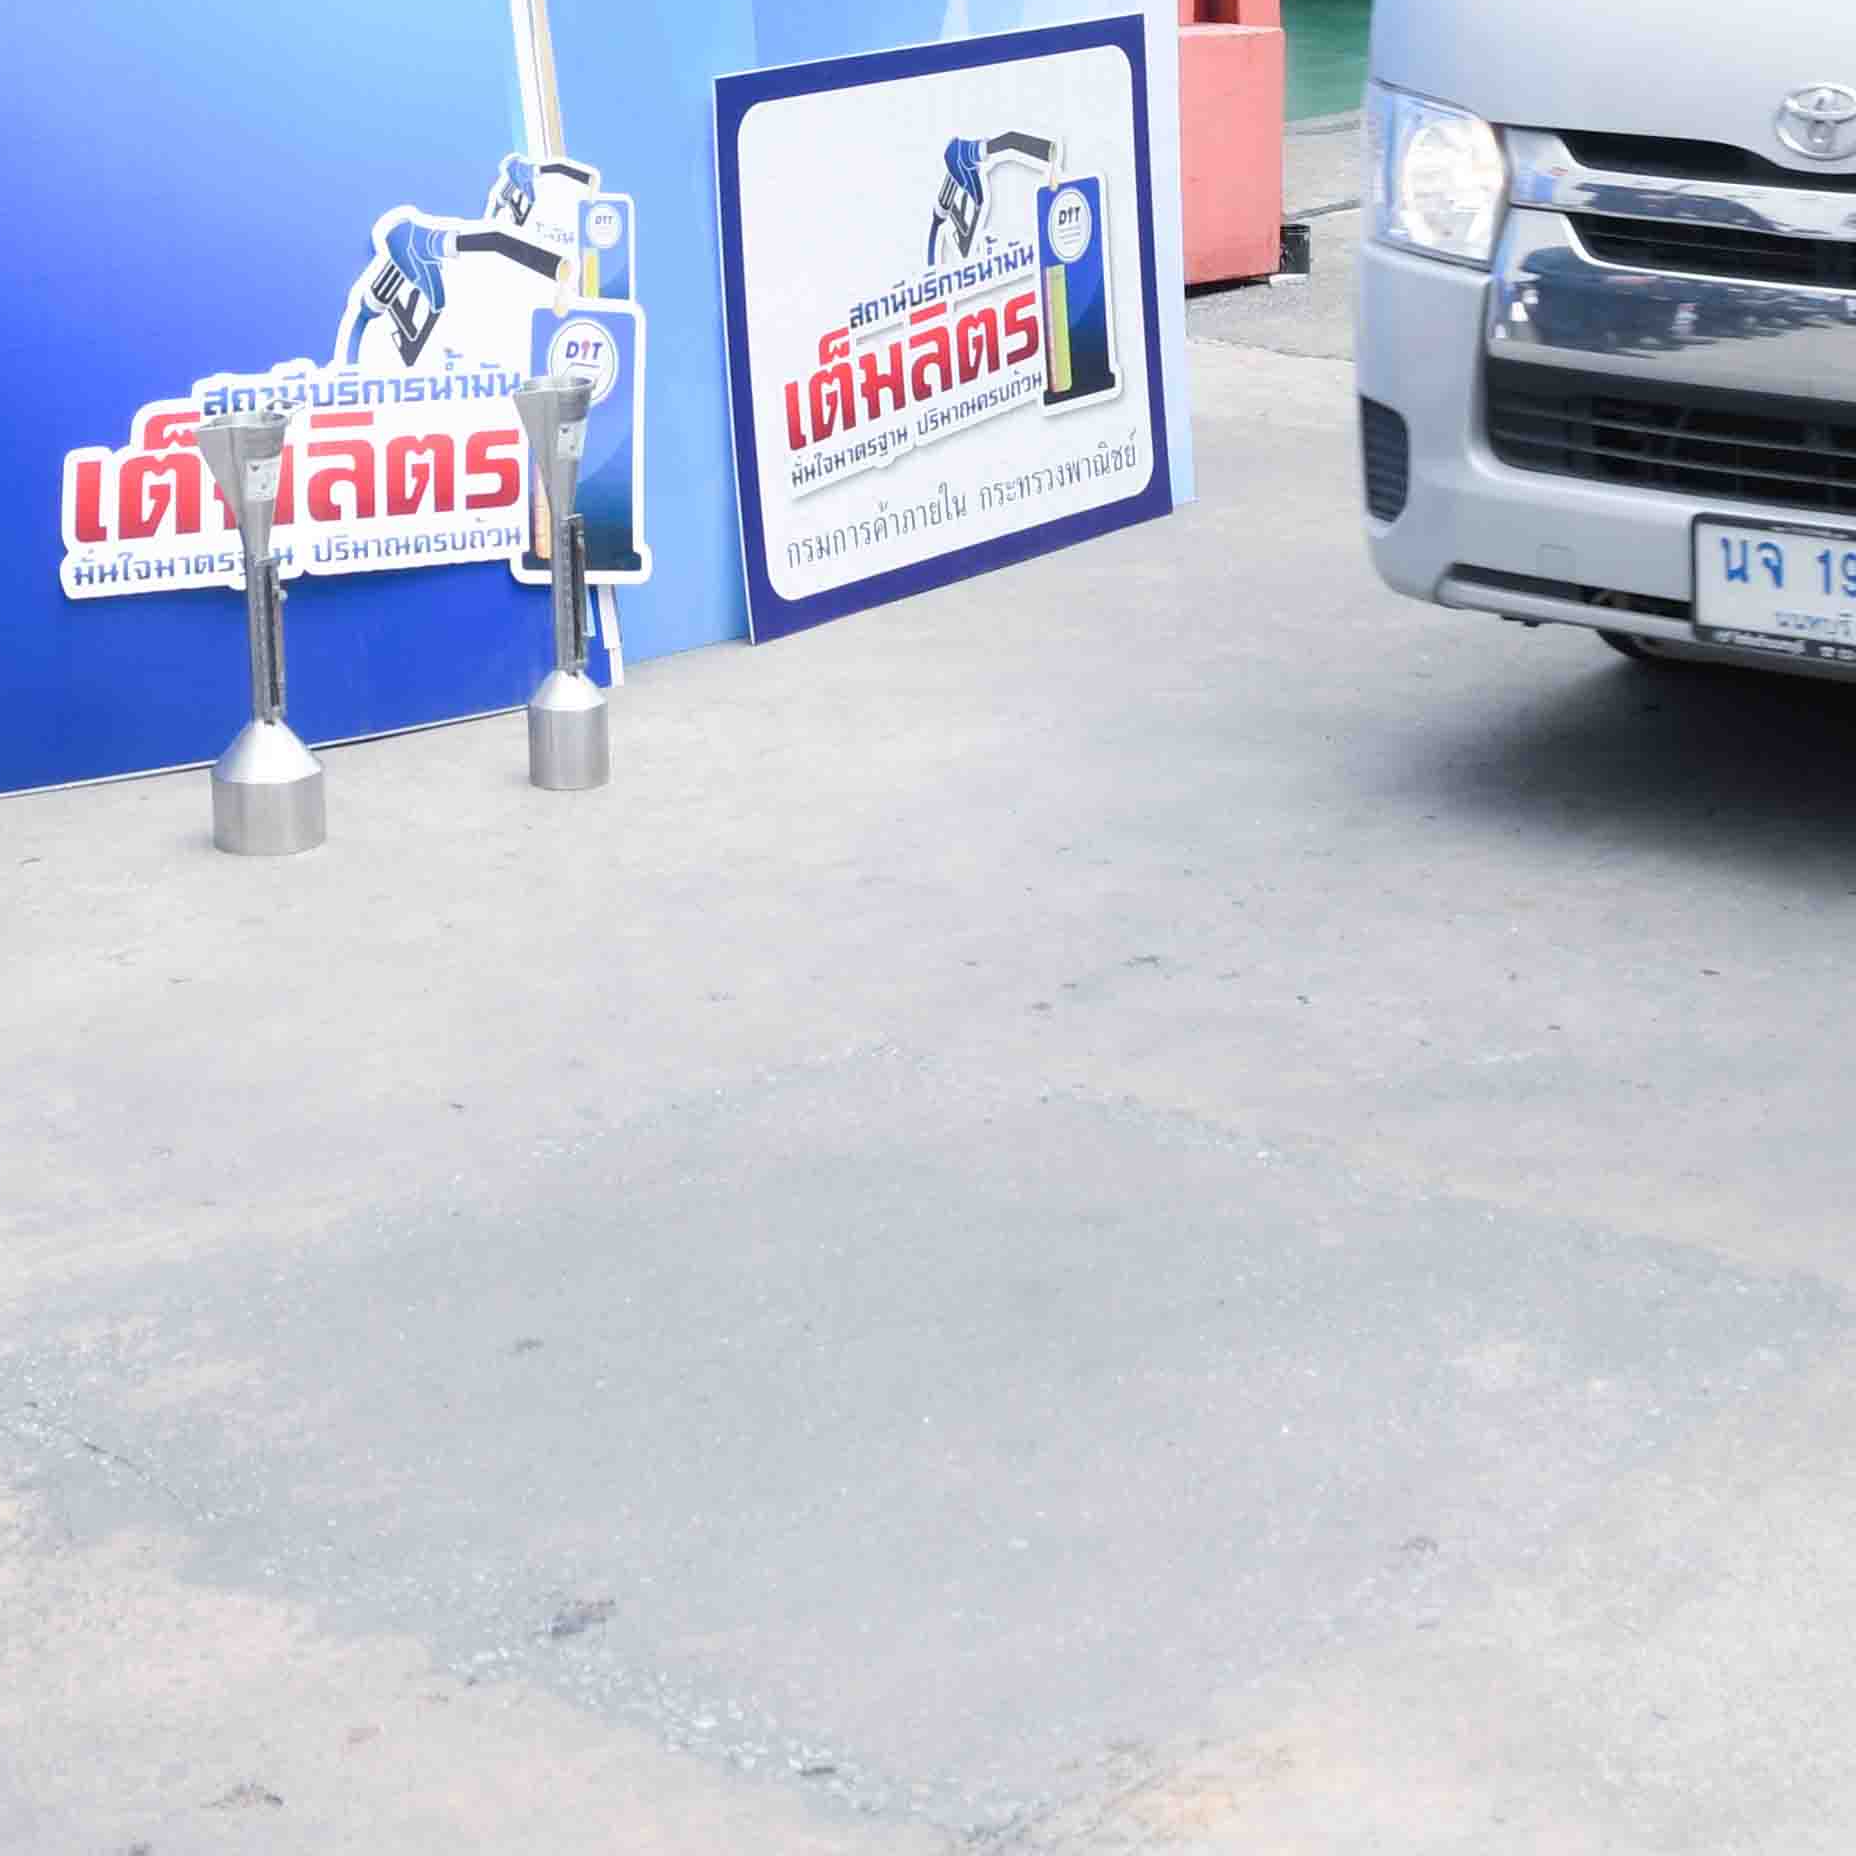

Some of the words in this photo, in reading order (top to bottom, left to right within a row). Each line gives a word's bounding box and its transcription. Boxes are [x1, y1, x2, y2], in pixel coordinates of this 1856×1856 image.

[849, 240, 1036, 329] สถานีบริการน้ำมัน
[784, 290, 1040, 451] เต็มลิตร
[790, 428, 909, 485] มั่นใจมาตรฐาน
[916, 368, 1044, 437] ปริมาณครบถ้วน
[75, 411, 521, 544] เต็ลิตร
[786, 482, 969, 569] กรมการค้าภายใน
[978, 430, 1140, 511] กระทรวงพาณิชย์
[72, 548, 295, 587] มั่นใจมาตรน
[313, 518, 522, 564] ปริมาณครบถ้วน
